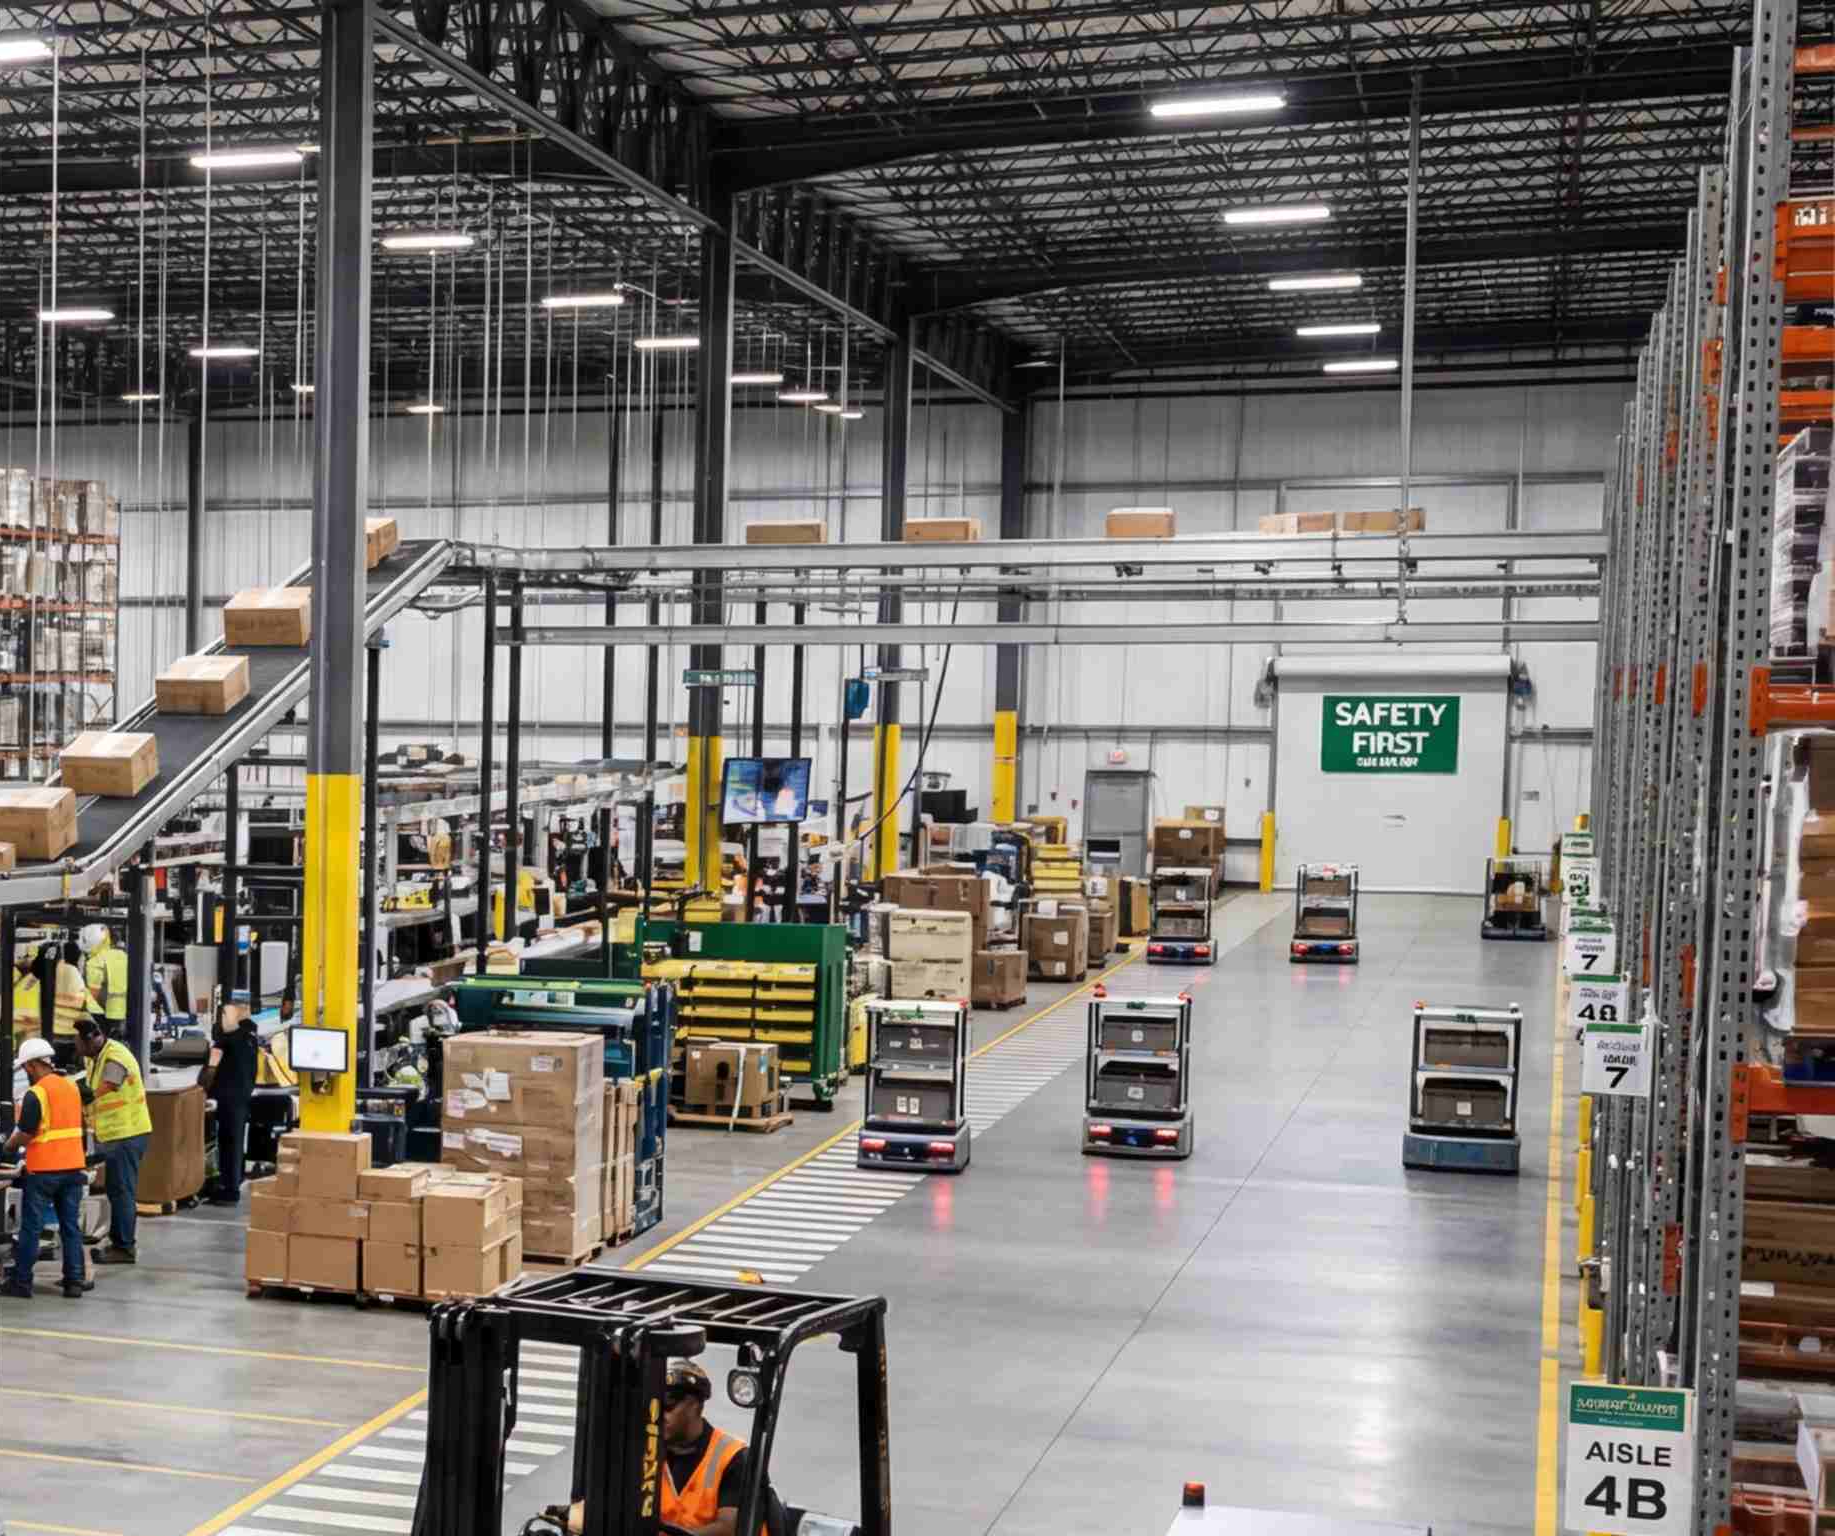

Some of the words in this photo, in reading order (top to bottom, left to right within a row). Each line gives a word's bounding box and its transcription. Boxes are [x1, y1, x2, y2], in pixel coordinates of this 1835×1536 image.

[1335, 701, 1447, 726] SAFETY
[1352, 731, 1430, 755] FIRST
[1605, 1066, 1629, 1089] 7
[1585, 1441, 1672, 1468] AISLE
[1584, 1475, 1667, 1521] 4B
